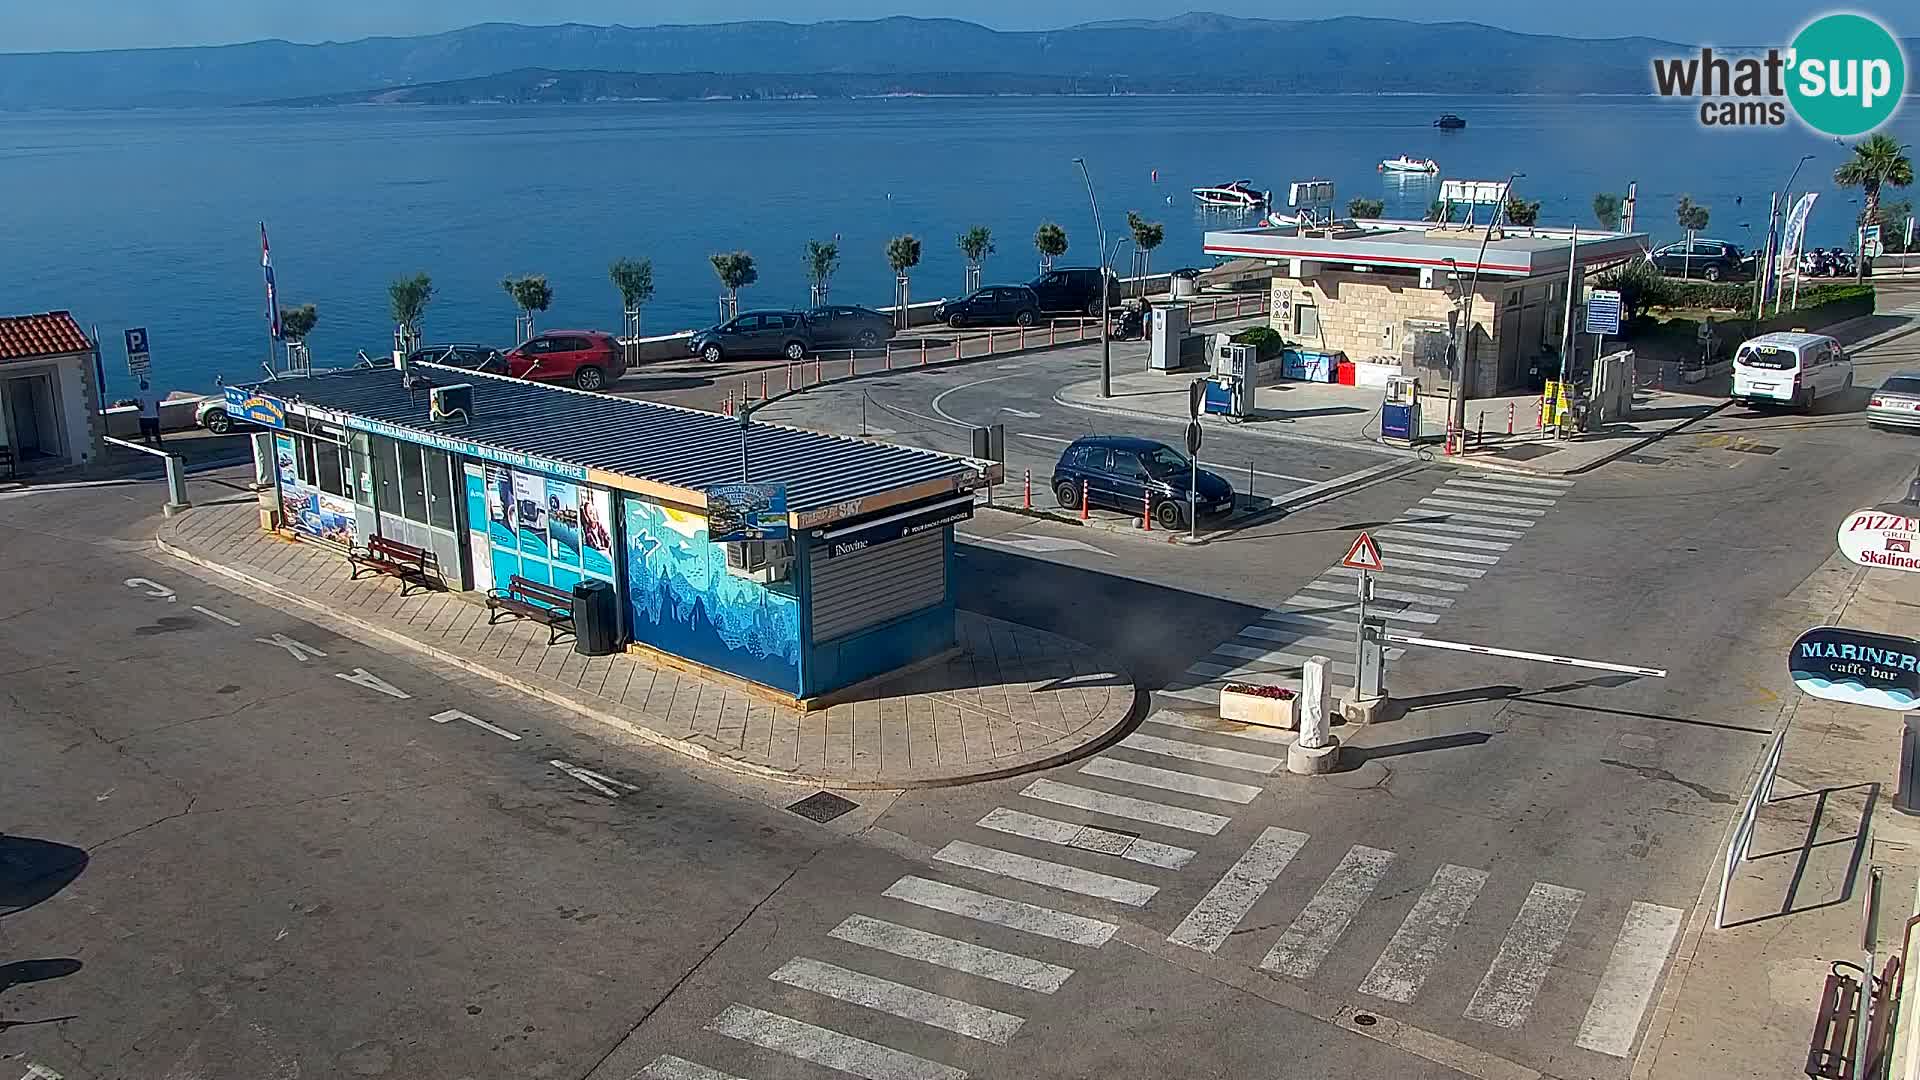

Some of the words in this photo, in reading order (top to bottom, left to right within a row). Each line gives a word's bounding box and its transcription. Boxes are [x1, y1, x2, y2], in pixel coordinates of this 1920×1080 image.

[436, 437, 469, 453] POSTAJA
[478, 446, 493, 459] BUS
[493, 449, 526, 466] STATION
[528, 457, 554, 472] TICKET
[555, 463, 583, 478] OFFICE
[1849, 515, 1920, 533] PIZZE
[1882, 530, 1918, 541] GRILL
[1800, 642, 1920, 674] MARINER
[1829, 663, 1867, 676] caffe
[1871, 666, 1898, 681] bar
